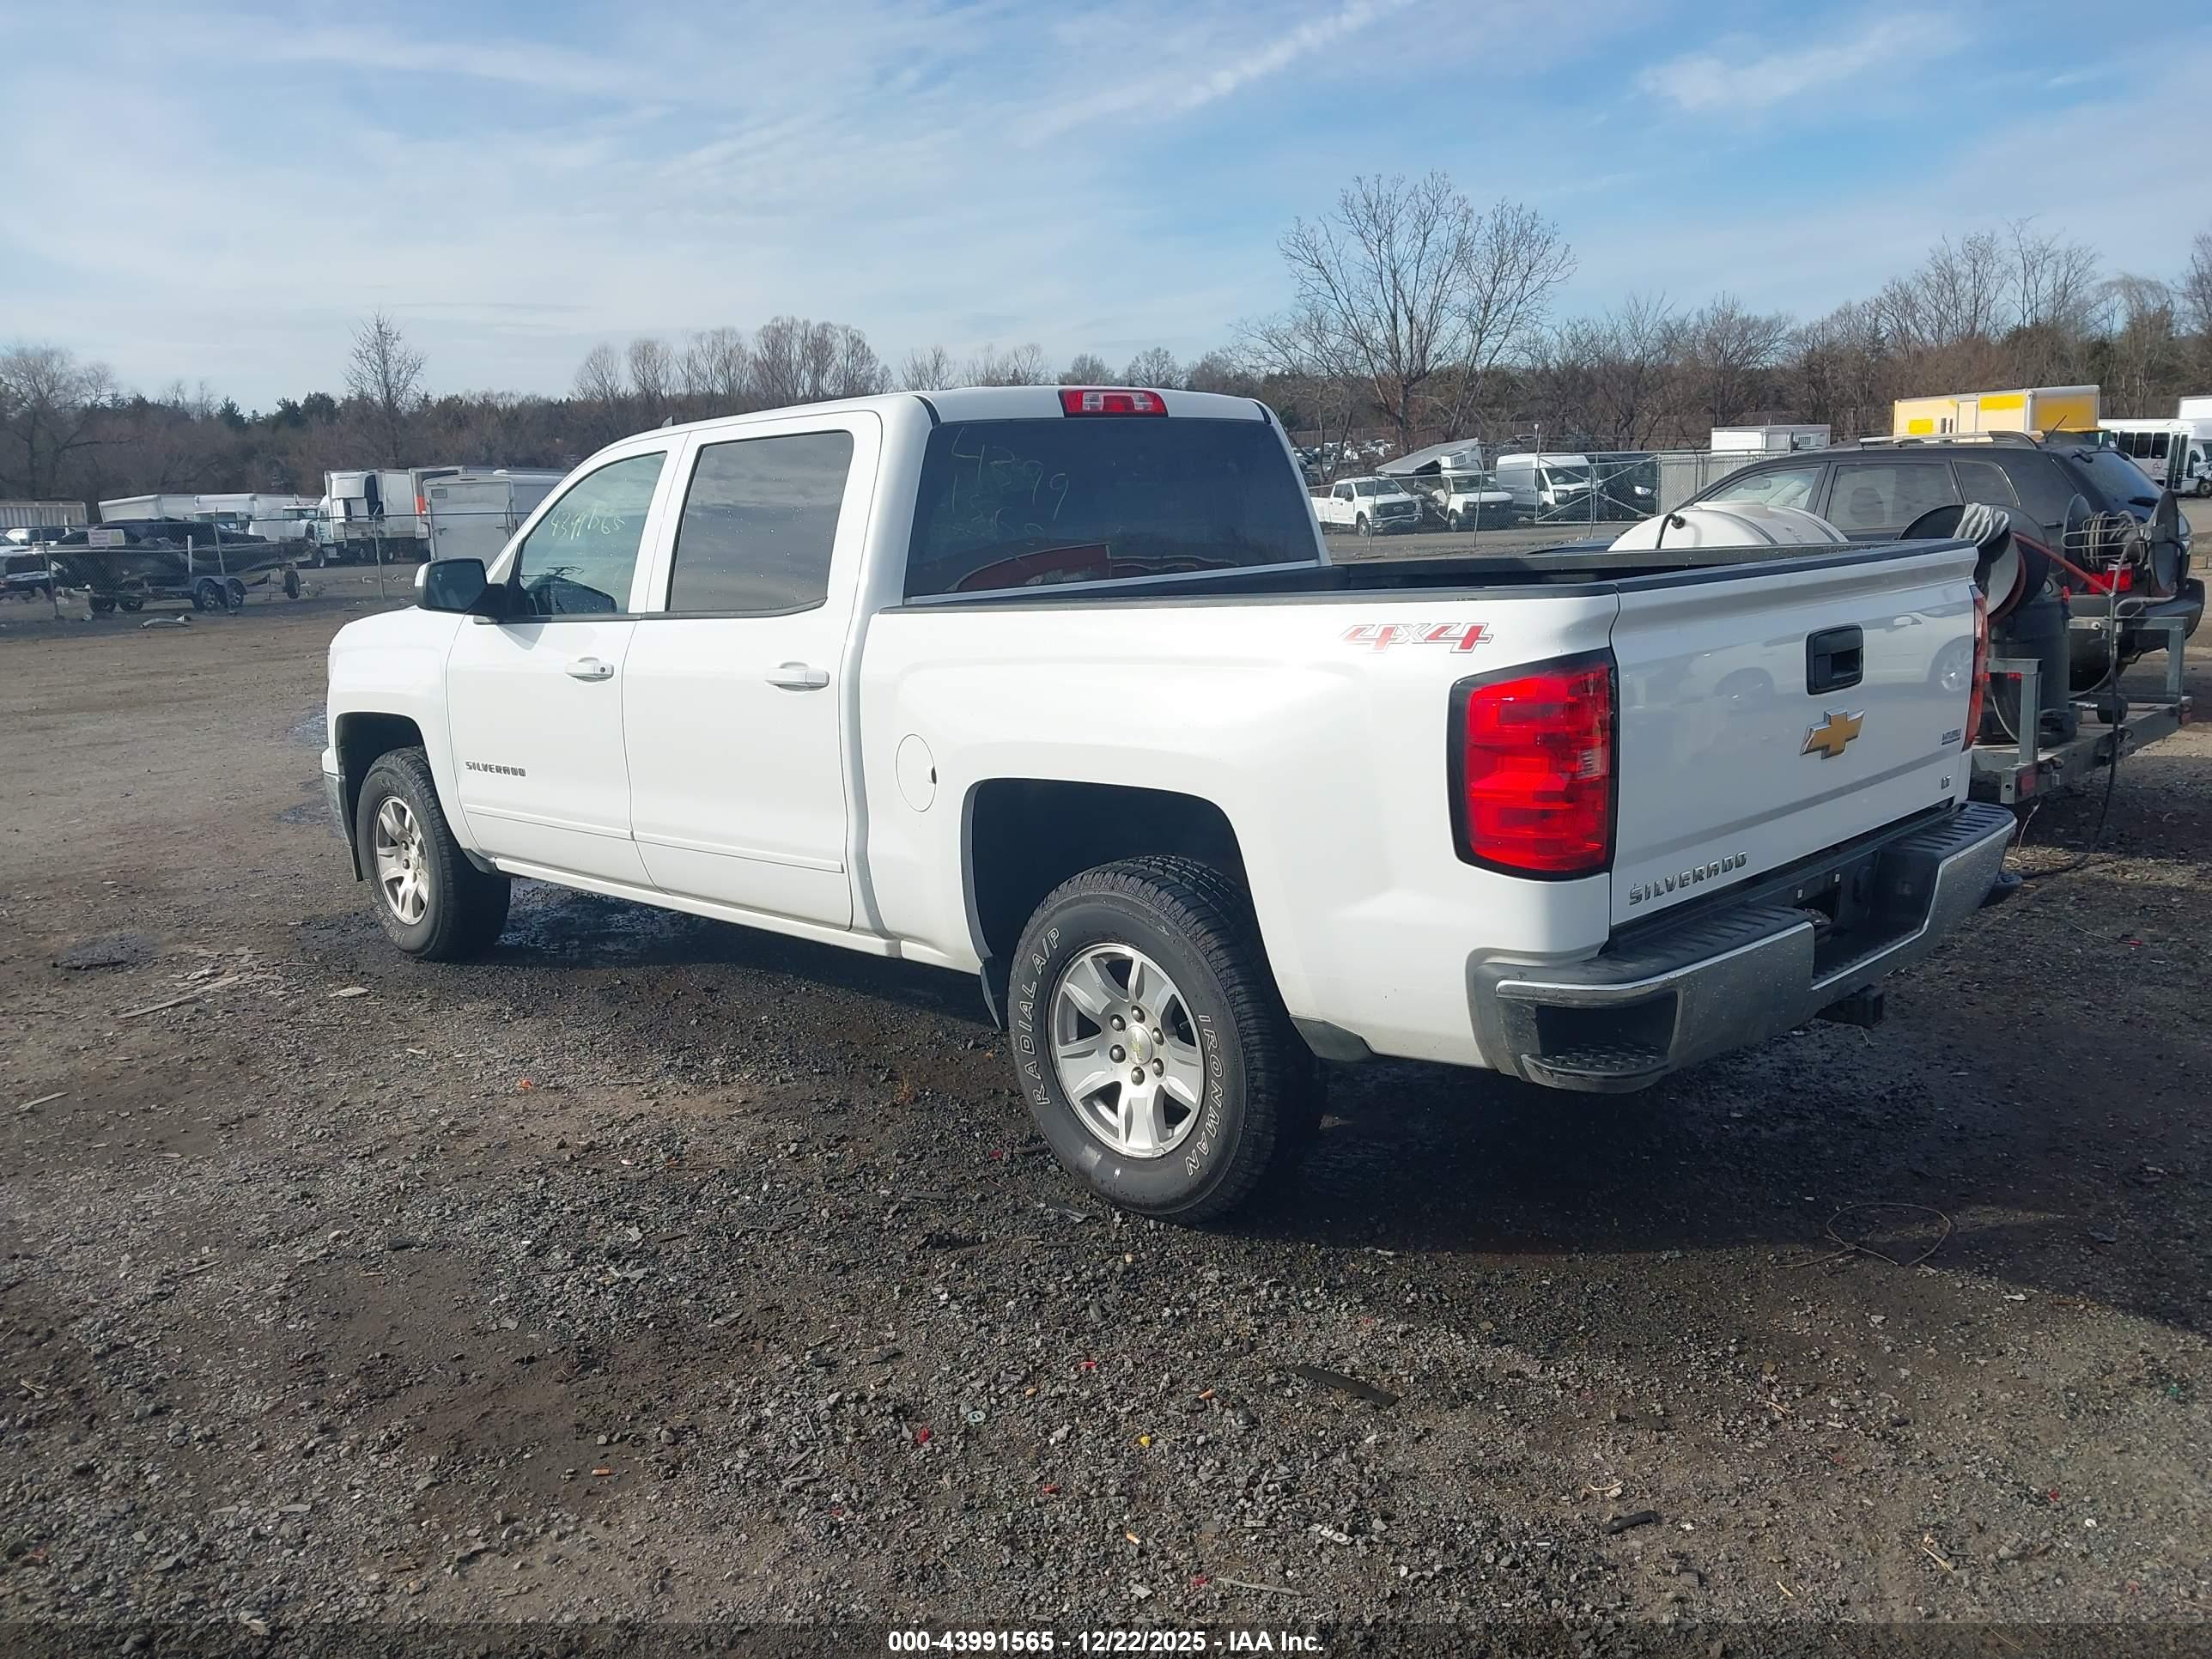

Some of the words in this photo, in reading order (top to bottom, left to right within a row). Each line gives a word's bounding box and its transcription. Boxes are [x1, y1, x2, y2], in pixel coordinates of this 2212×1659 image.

[465, 761, 526, 777] SILVERADO
[1629, 851, 1747, 906] SILVERADO
[1032, 927, 1061, 975] A/P
[1019, 981, 1051, 1106] RADIAL
[1186, 1014, 1224, 1176] IRONMAN
